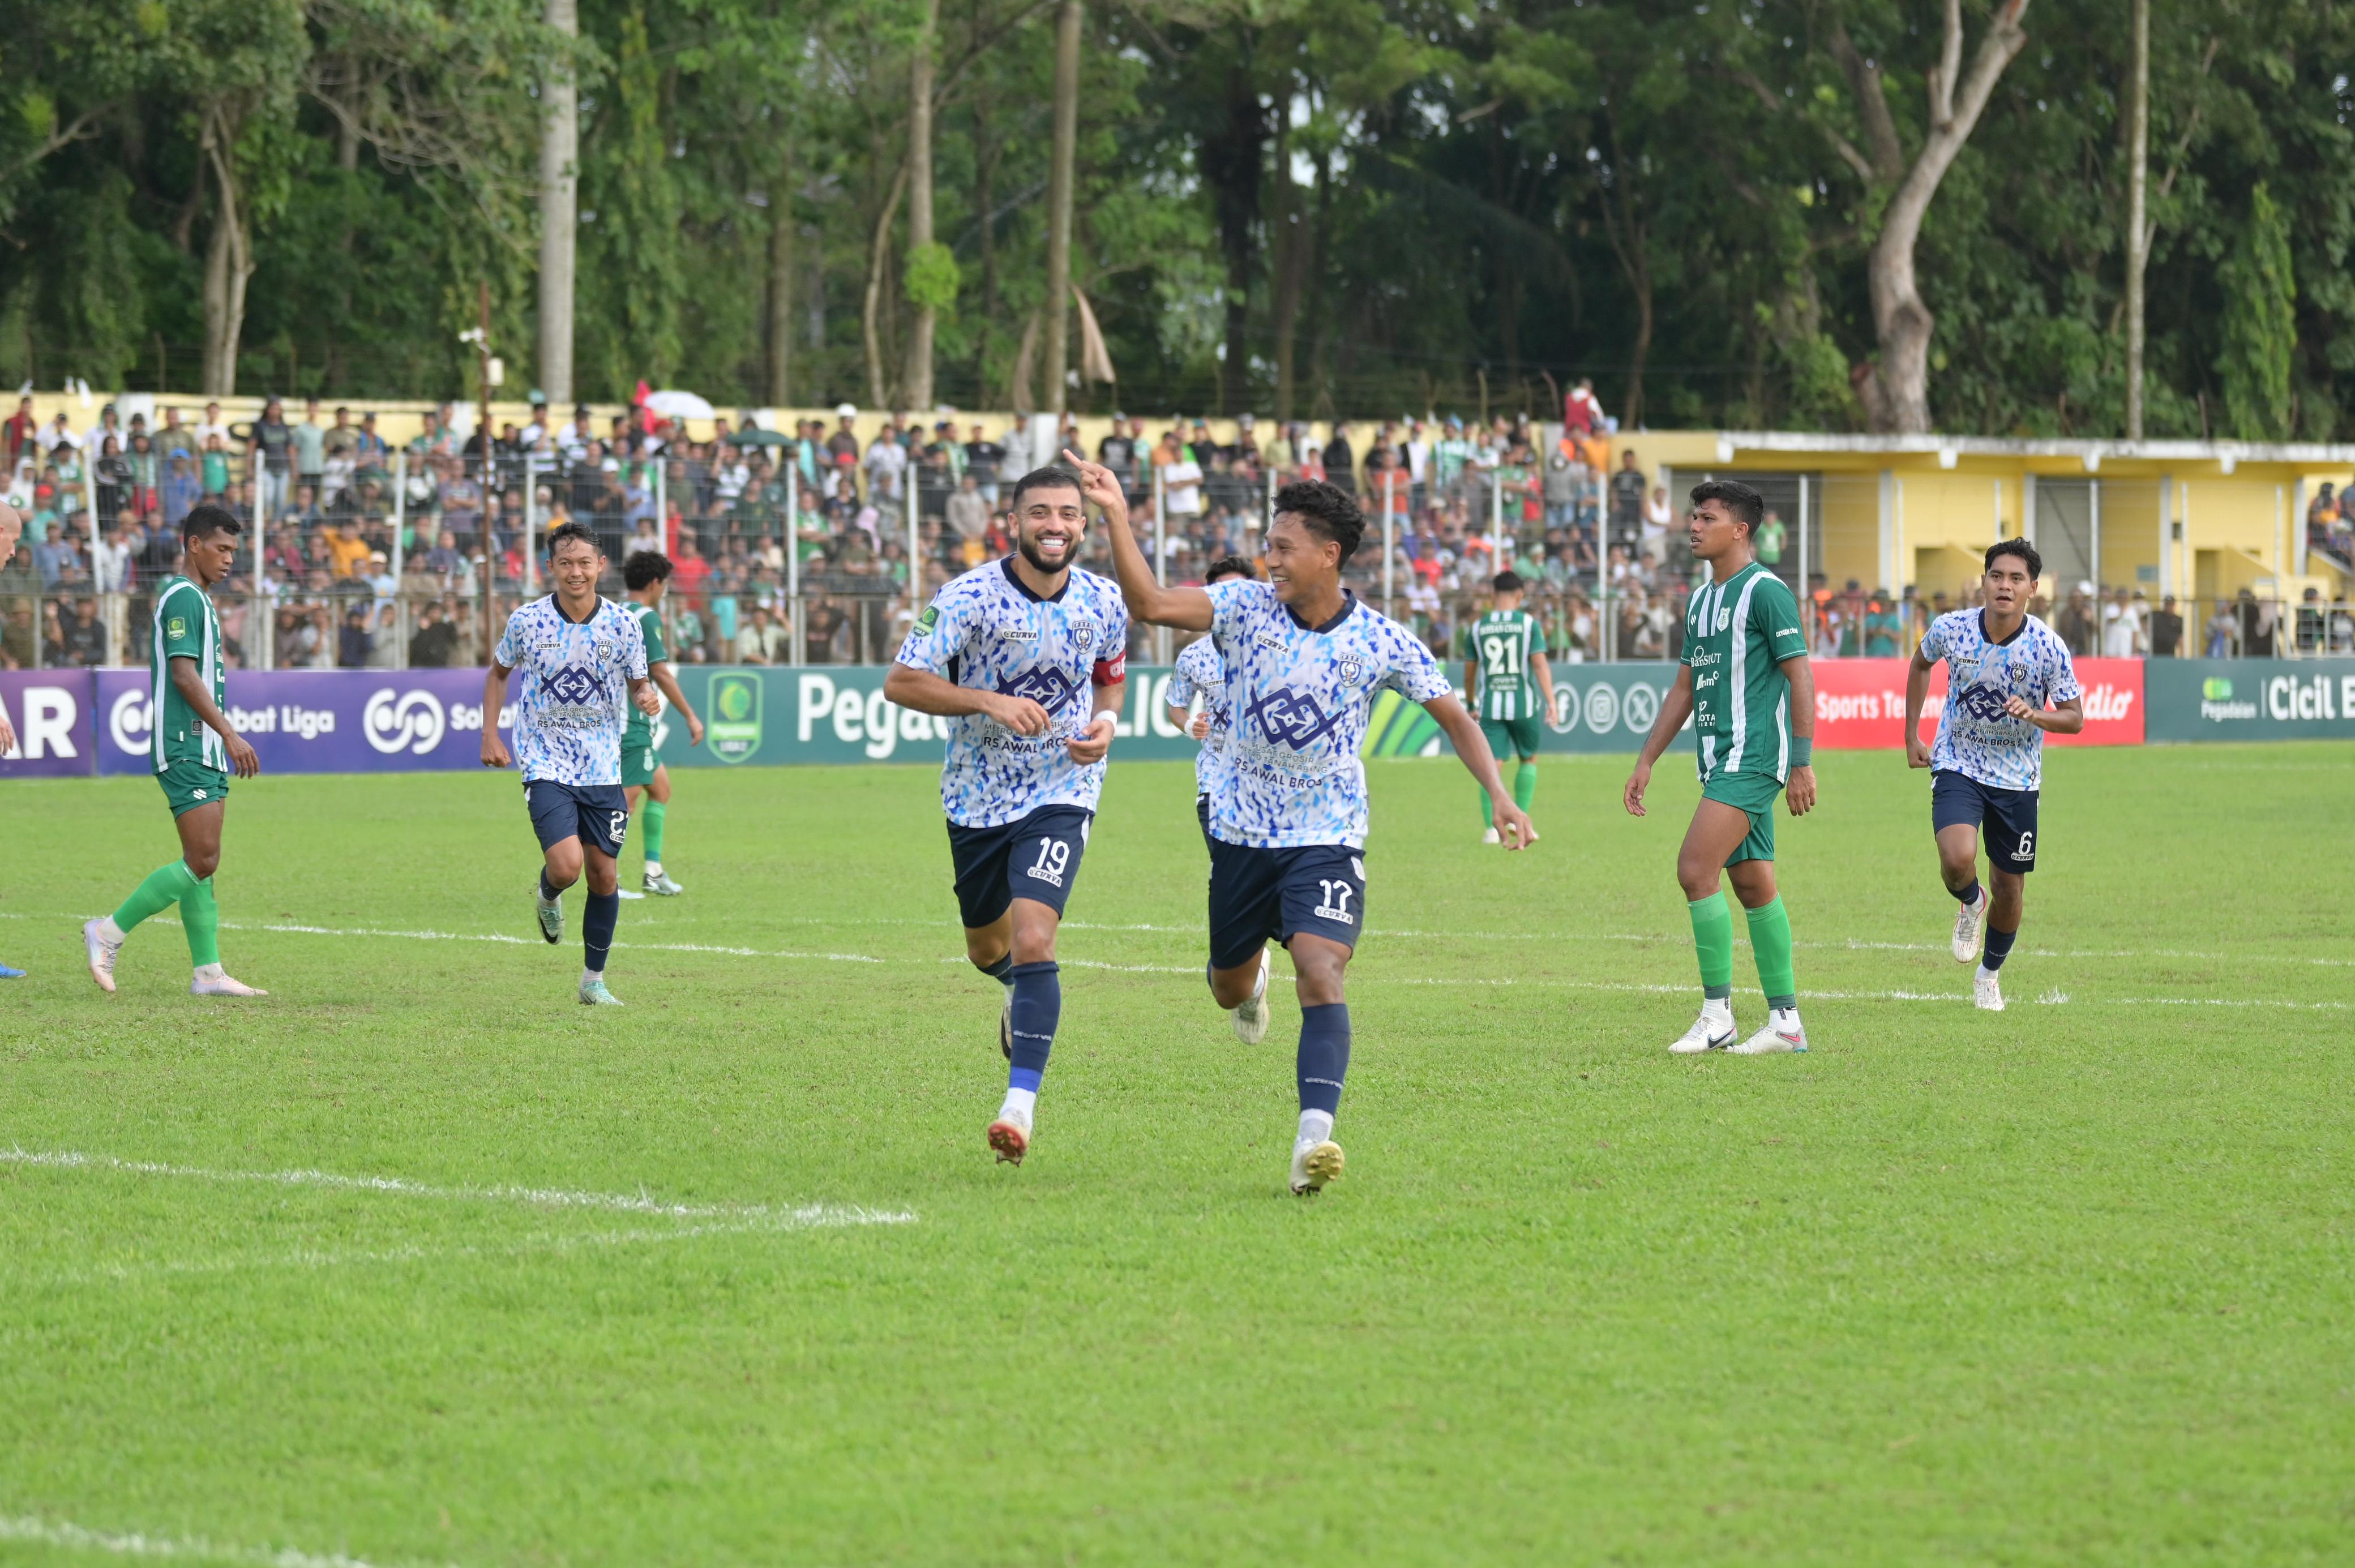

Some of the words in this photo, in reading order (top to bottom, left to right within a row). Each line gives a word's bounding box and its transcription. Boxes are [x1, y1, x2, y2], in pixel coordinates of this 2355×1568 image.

[1262, 639, 1288, 654] CURVA
[1484, 636, 1519, 675] 21
[1817, 691, 1879, 723] Sports
[2269, 674, 2336, 721] Cicil
[225, 705, 277, 732] bat
[282, 705, 335, 740] Liga
[579, 719, 601, 729] BROS
[798, 674, 948, 759] Pega
[984, 724, 1013, 735] METRO
[1965, 732, 1988, 745] AWAL
[1991, 738, 2015, 747] BROS
[984, 736, 999, 748] RS
[1001, 740, 1037, 753] AWAL
[1279, 752, 1314, 763] GROSIR
[1235, 757, 1248, 771] RS
[1251, 766, 1284, 785] AWAL
[1290, 777, 1322, 789] BROS
[611, 810, 629, 837] 2
[2018, 831, 2032, 855] 6
[1036, 836, 1070, 876] 19
[1035, 870, 1060, 885] CURVA
[1319, 879, 1352, 913] 17
[1324, 910, 1351, 922] CURVA
